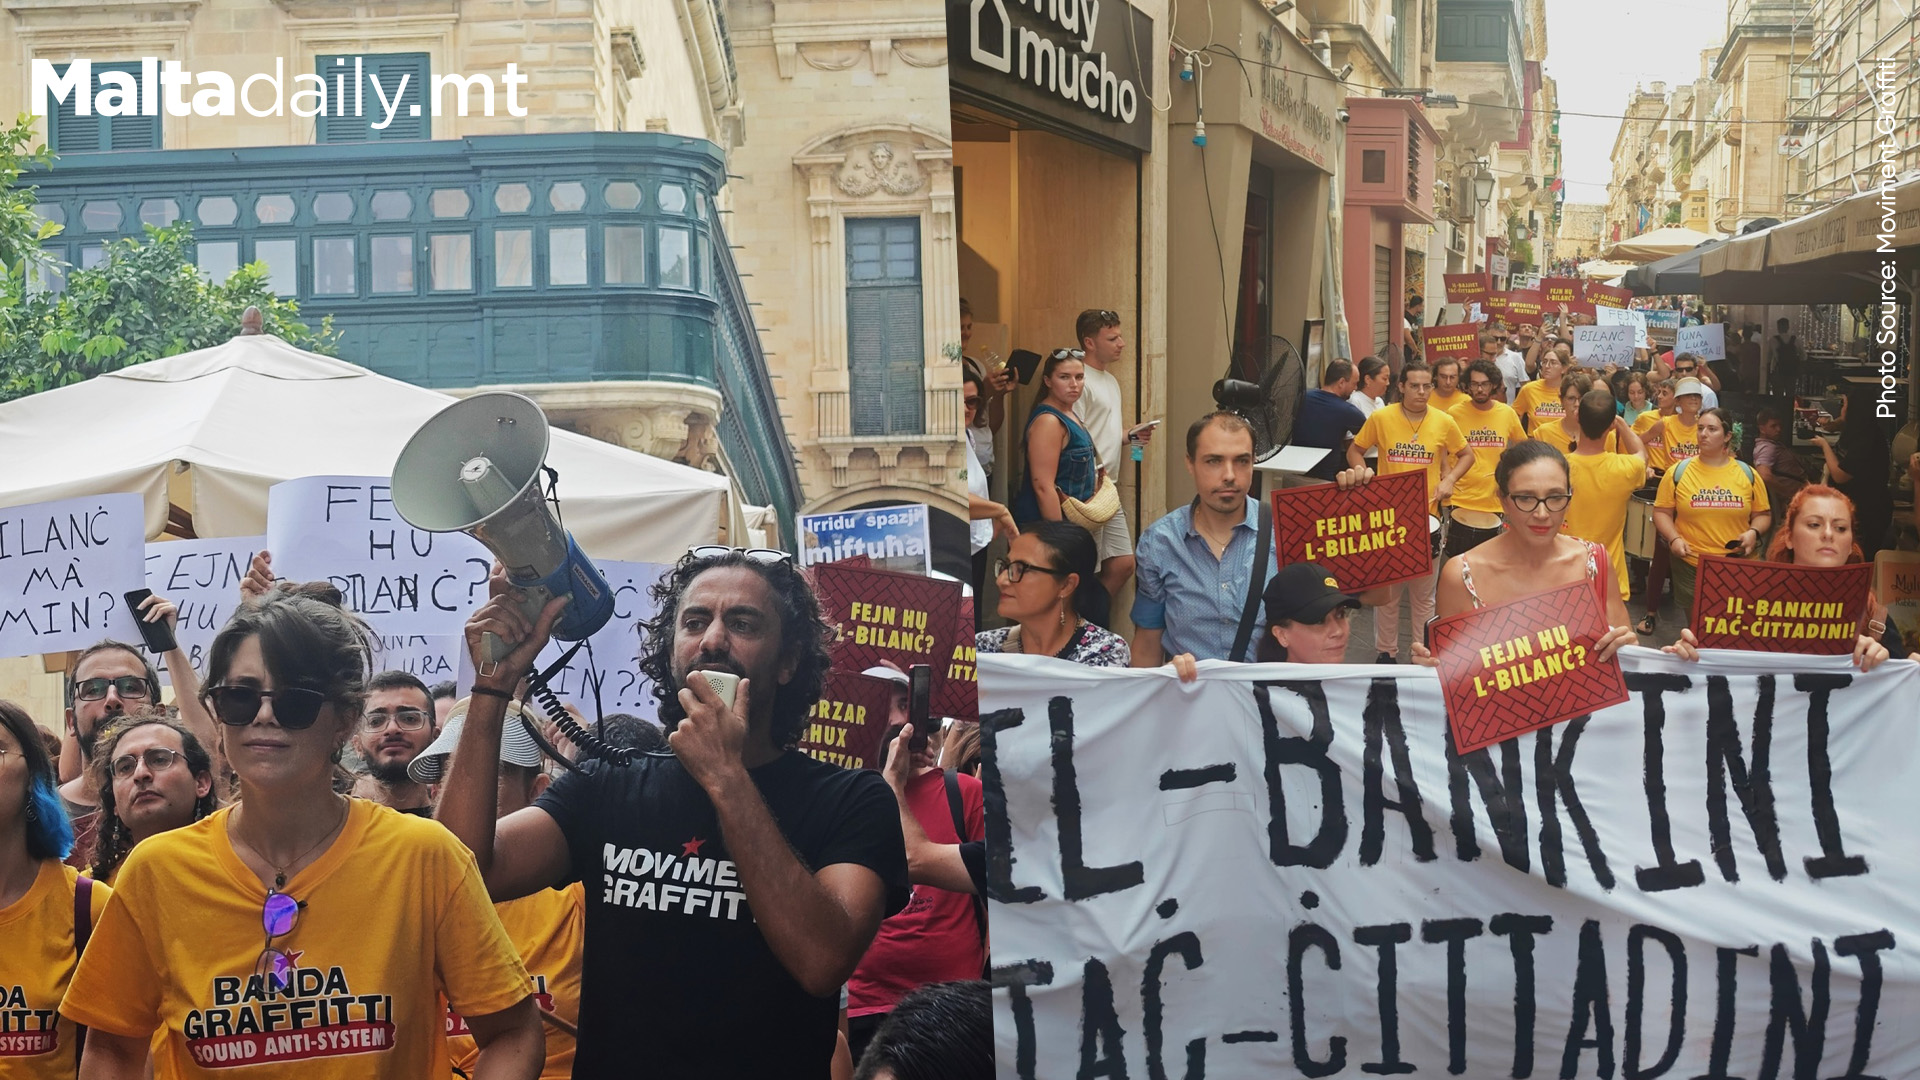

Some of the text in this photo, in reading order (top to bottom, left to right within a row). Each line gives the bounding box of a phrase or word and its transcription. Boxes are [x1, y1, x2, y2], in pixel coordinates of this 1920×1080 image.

[1018, 0, 1100, 53] uy
[1019, 26, 1137, 124] mucho
[1608, 309, 1640, 322] FEJN
[1579, 330, 1625, 342] BILANĊ
[1396, 442, 1426, 451] BANDA
[807, 515, 856, 534] Irridu
[1316, 508, 1396, 537] FEJN HU
[1305, 525, 1408, 561] L-BILANĊ?
[0, 591, 116, 636] MIN?
[850, 601, 928, 630] FEJN HU
[1726, 596, 1844, 619] IL-BANKINI
[1704, 615, 1856, 640] TAĊ-ĊITTADINI!
[1479, 624, 1570, 669] FEJN HU
[1473, 644, 1587, 698] L-BILANĊ?
[602, 873, 757, 924] GRAFFIT
[214, 966, 349, 1005] BANDA
[184, 994, 392, 1040] GRAFFITTI
[194, 1027, 386, 1063] SOUND ANTI-SYSTEM
